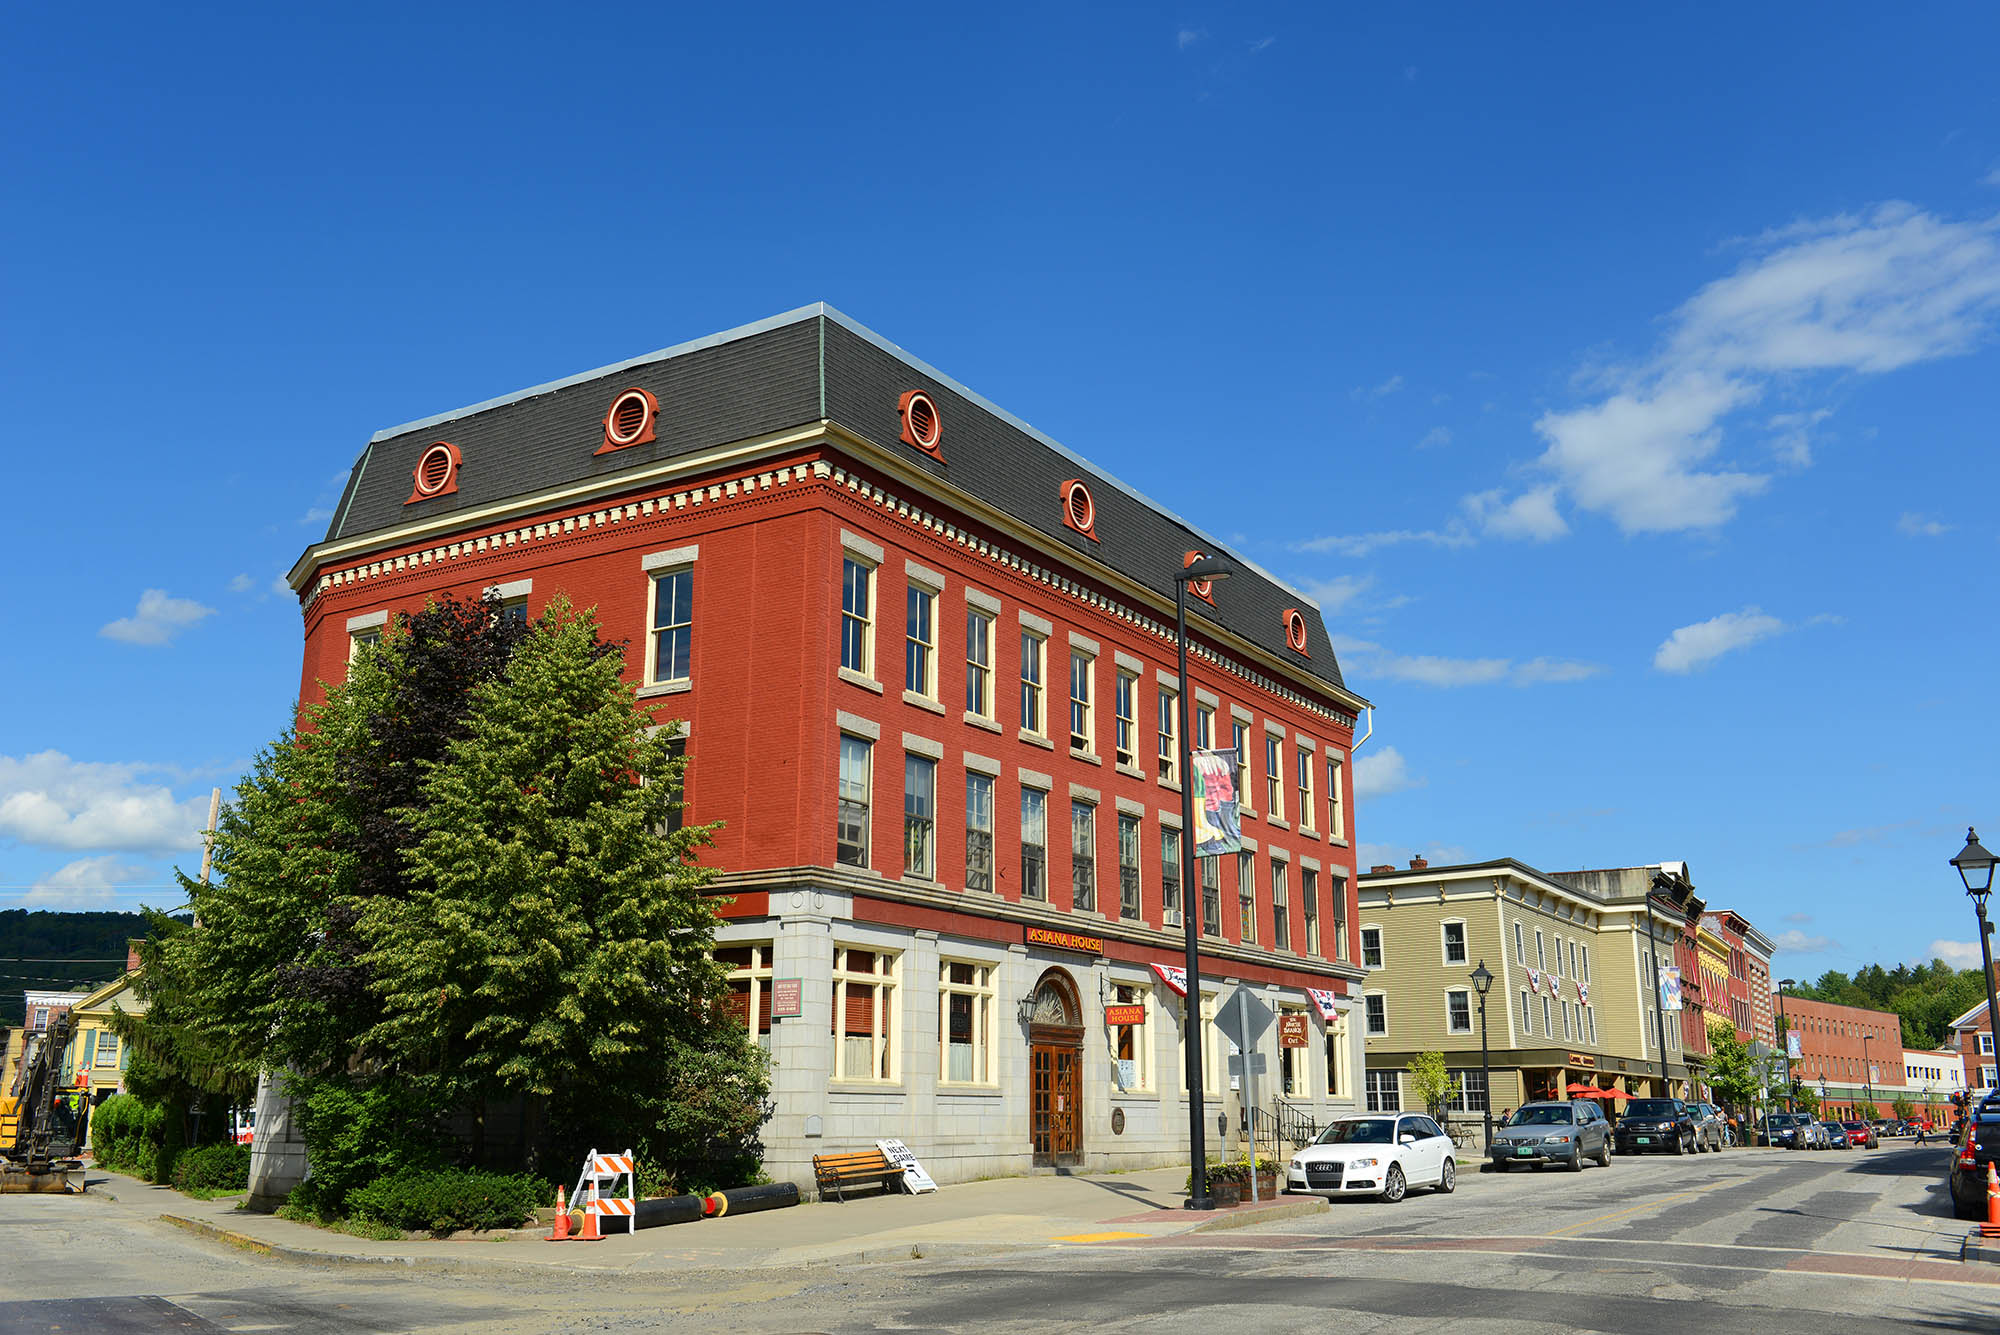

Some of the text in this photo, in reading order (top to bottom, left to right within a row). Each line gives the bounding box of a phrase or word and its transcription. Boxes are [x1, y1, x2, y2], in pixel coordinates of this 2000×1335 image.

[1030, 929, 1101, 951] ASIANA HOUSE
[1110, 1008, 1141, 1016] ASIANA
[1111, 1015, 1139, 1023] HOUSE
[886, 1145, 909, 1154] NEXT
[892, 1153, 916, 1162] GAME
